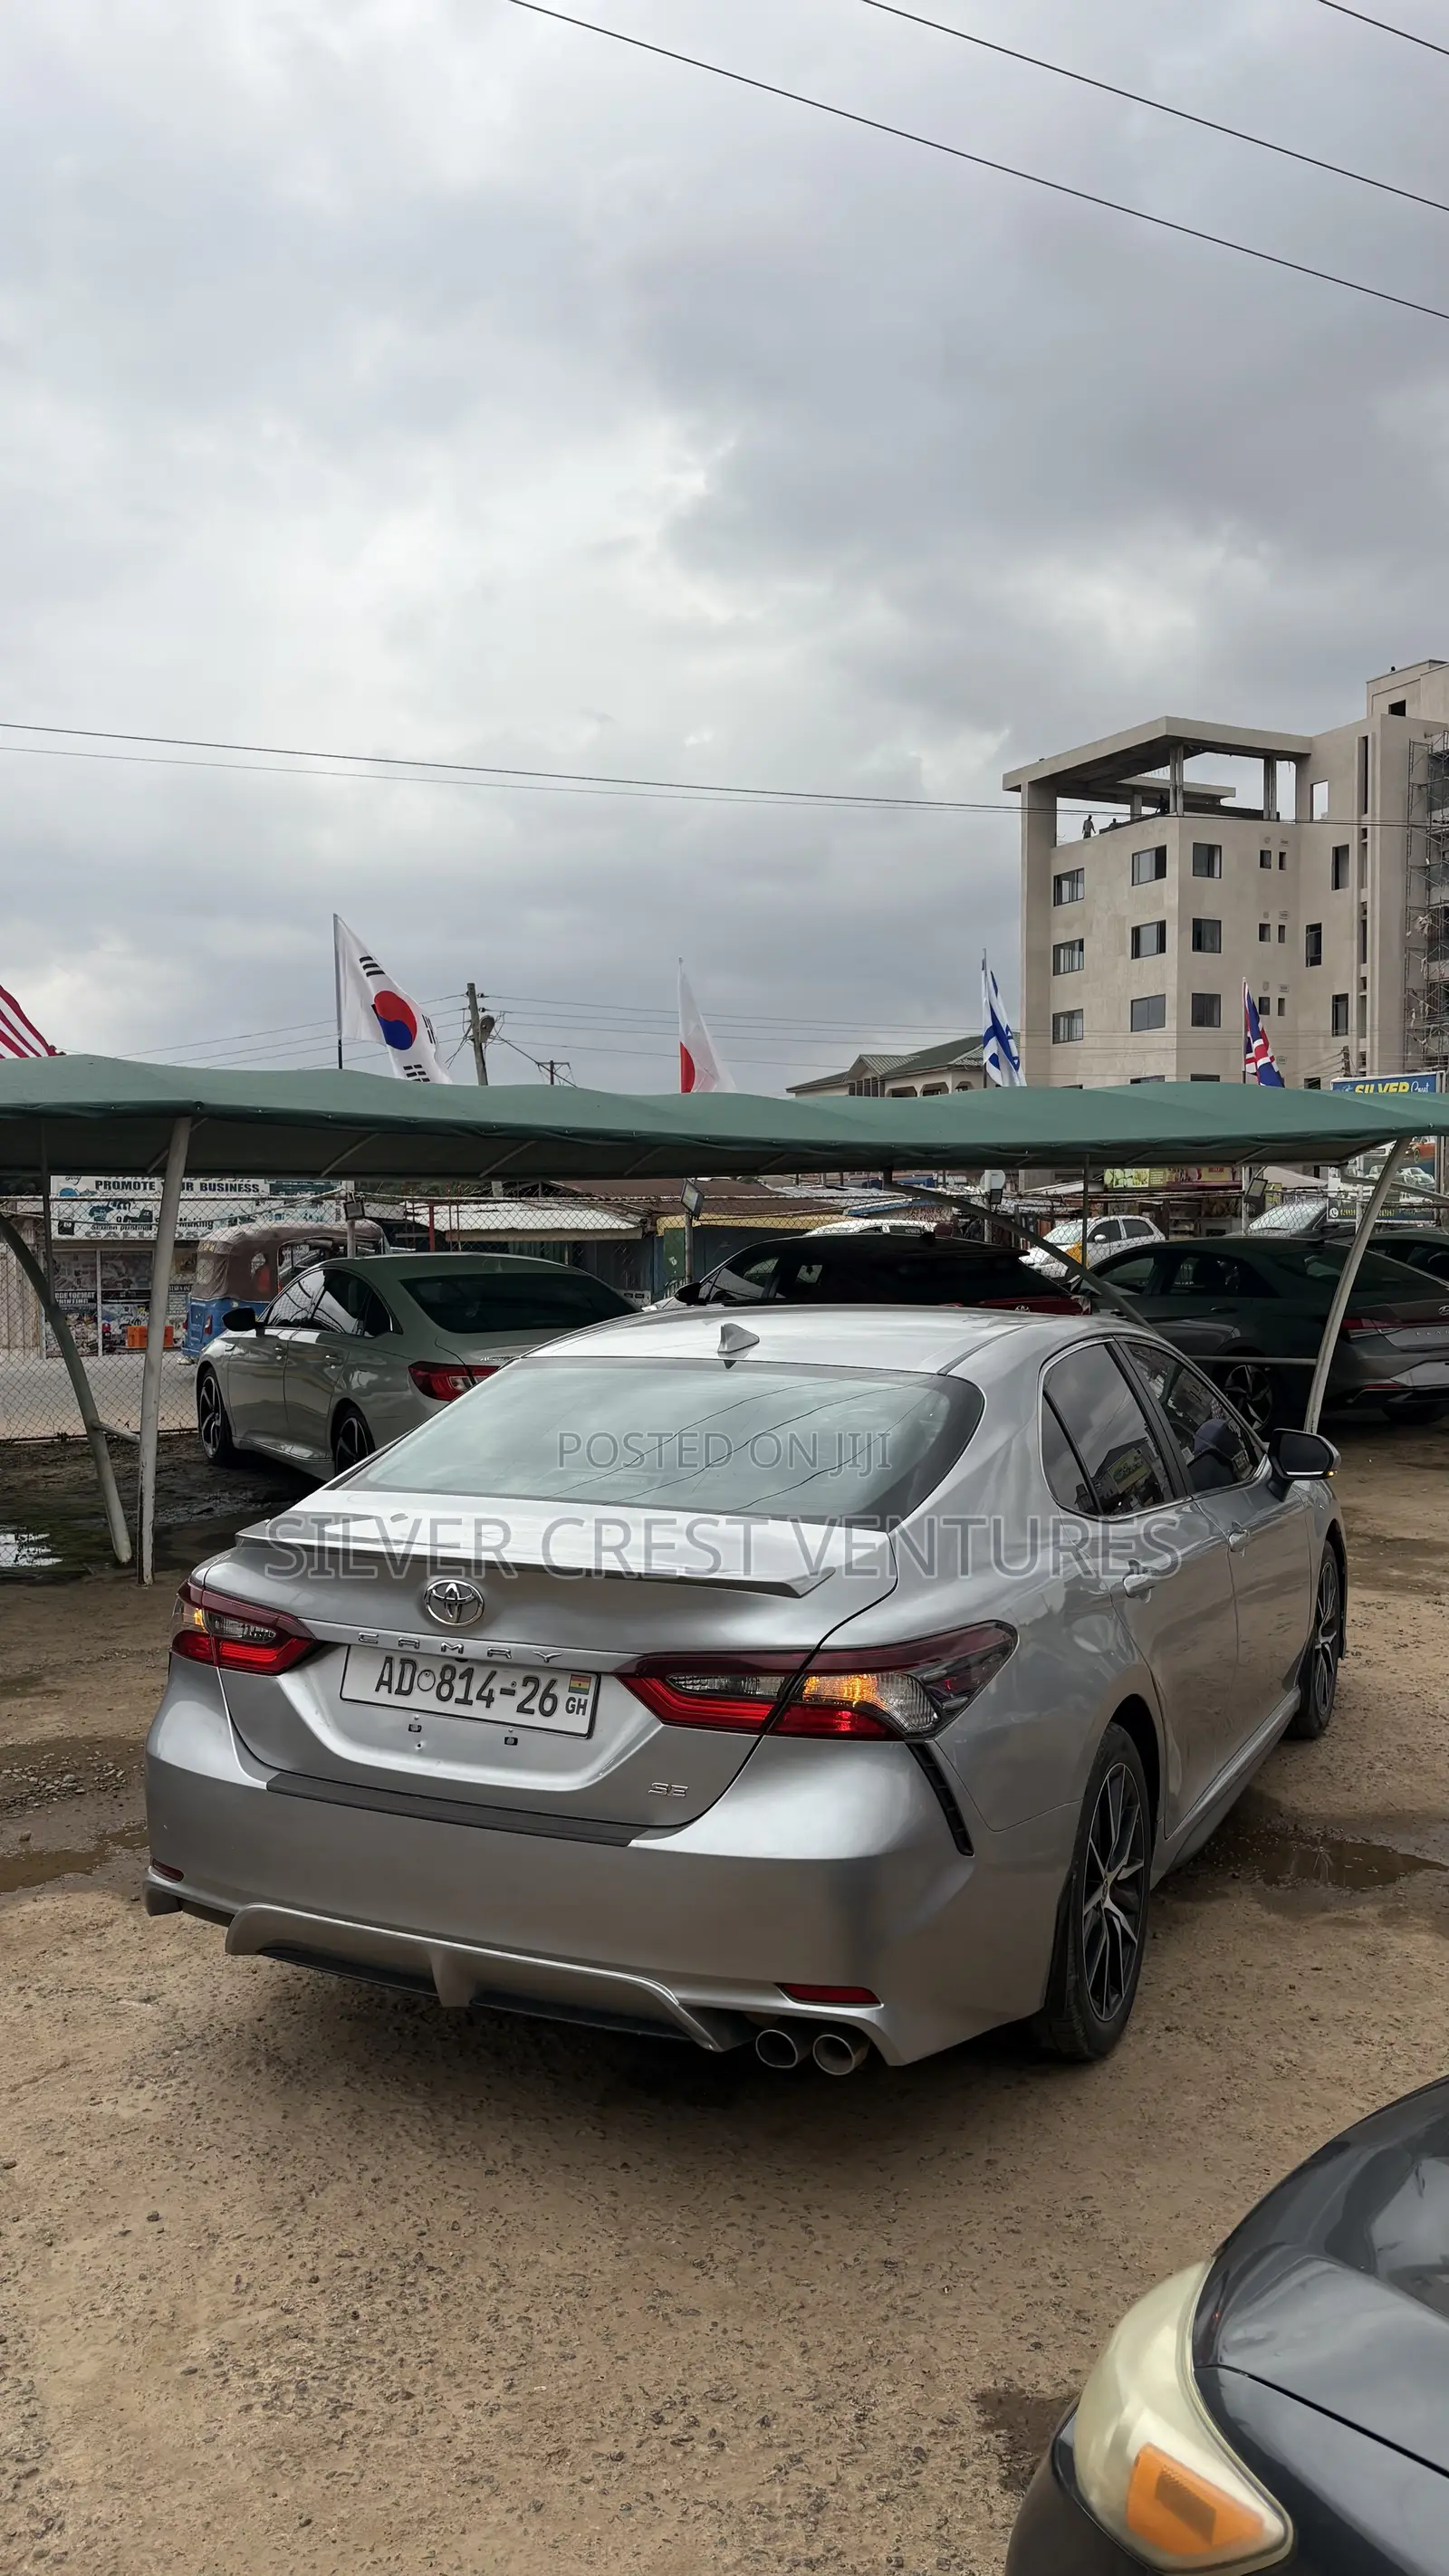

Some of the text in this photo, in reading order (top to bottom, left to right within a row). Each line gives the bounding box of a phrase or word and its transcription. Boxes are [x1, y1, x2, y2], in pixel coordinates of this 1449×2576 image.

[94, 1180, 156, 1191] PROMOTE
[199, 1182, 260, 1192] BUSINESS
[358, 1631, 563, 1663] CAMRY
[564, 1696, 589, 1717] GH
[648, 1781, 690, 1797] SE
